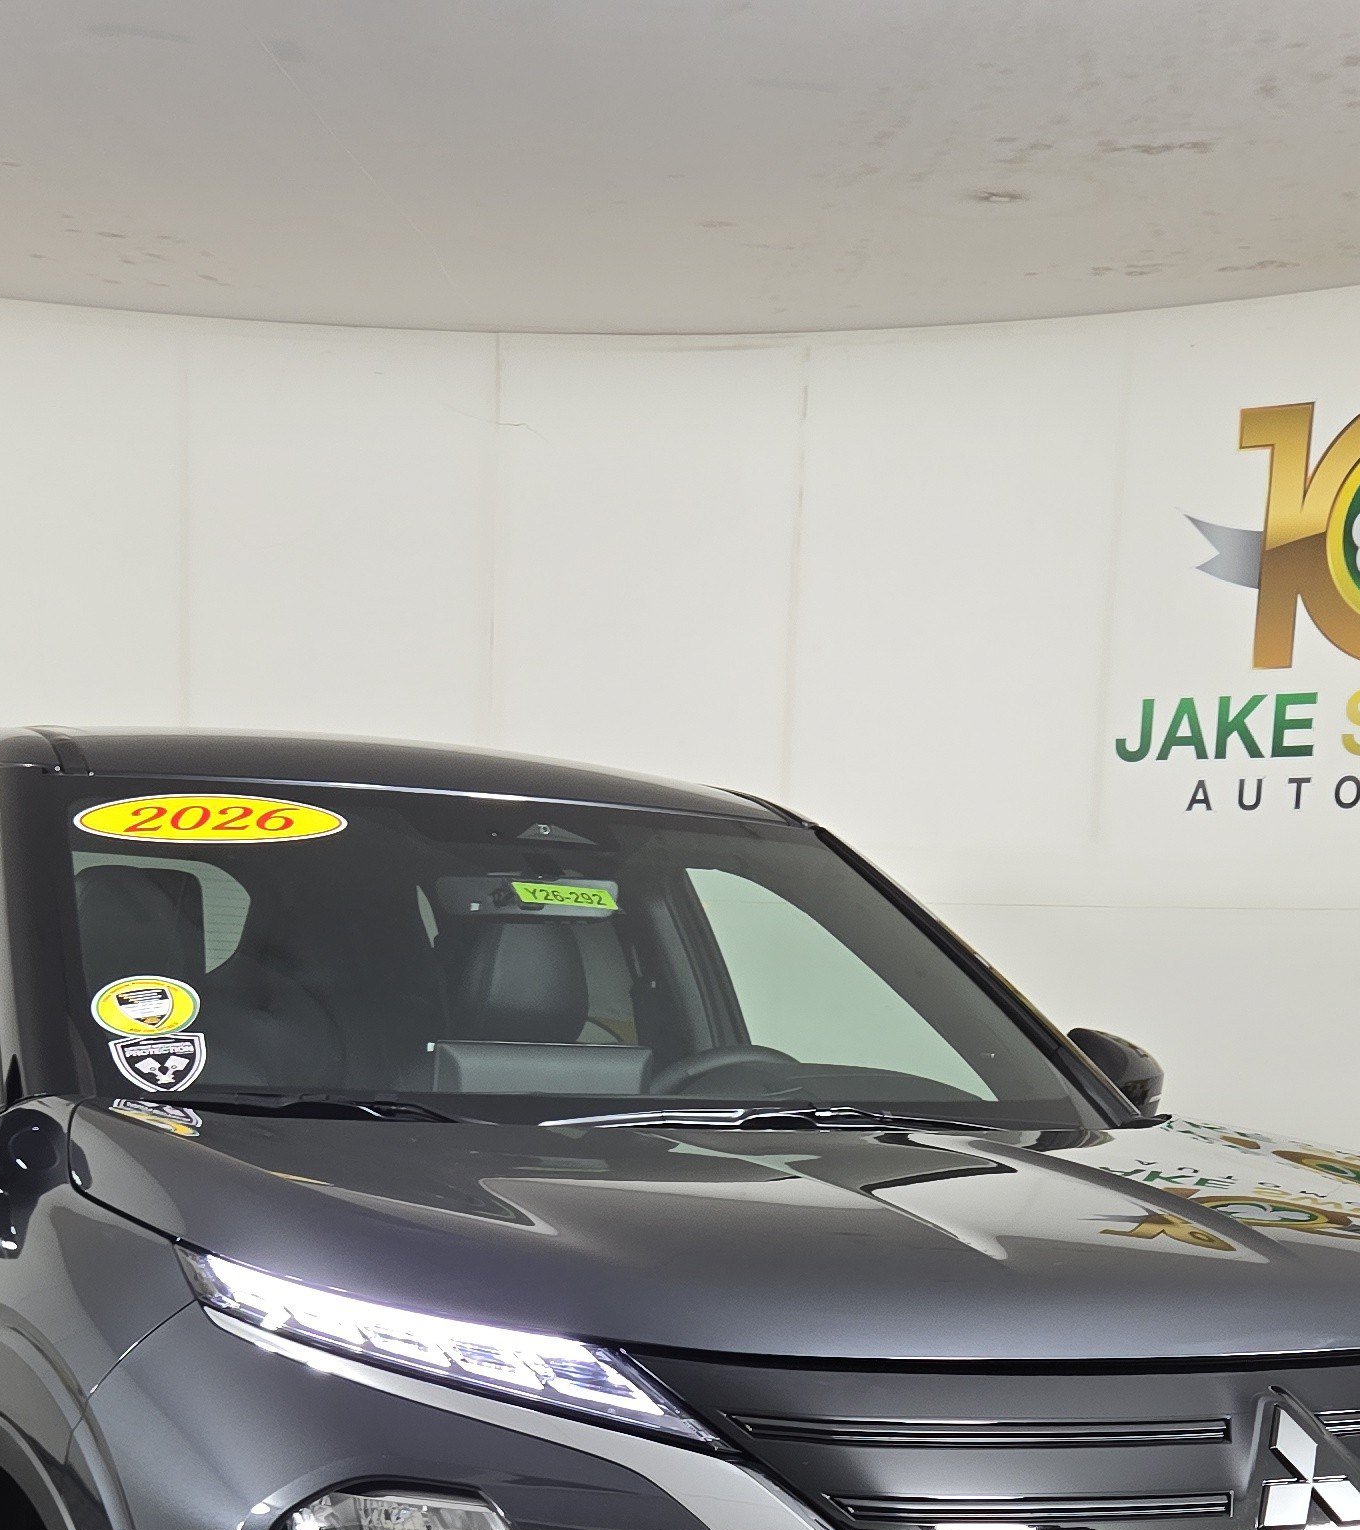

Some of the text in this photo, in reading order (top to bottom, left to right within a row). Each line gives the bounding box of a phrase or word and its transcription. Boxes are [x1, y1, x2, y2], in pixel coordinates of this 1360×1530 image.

[1115, 691, 1318, 763] JAKE
[123, 806, 299, 832] 2026
[524, 887, 607, 906] Y26-292
